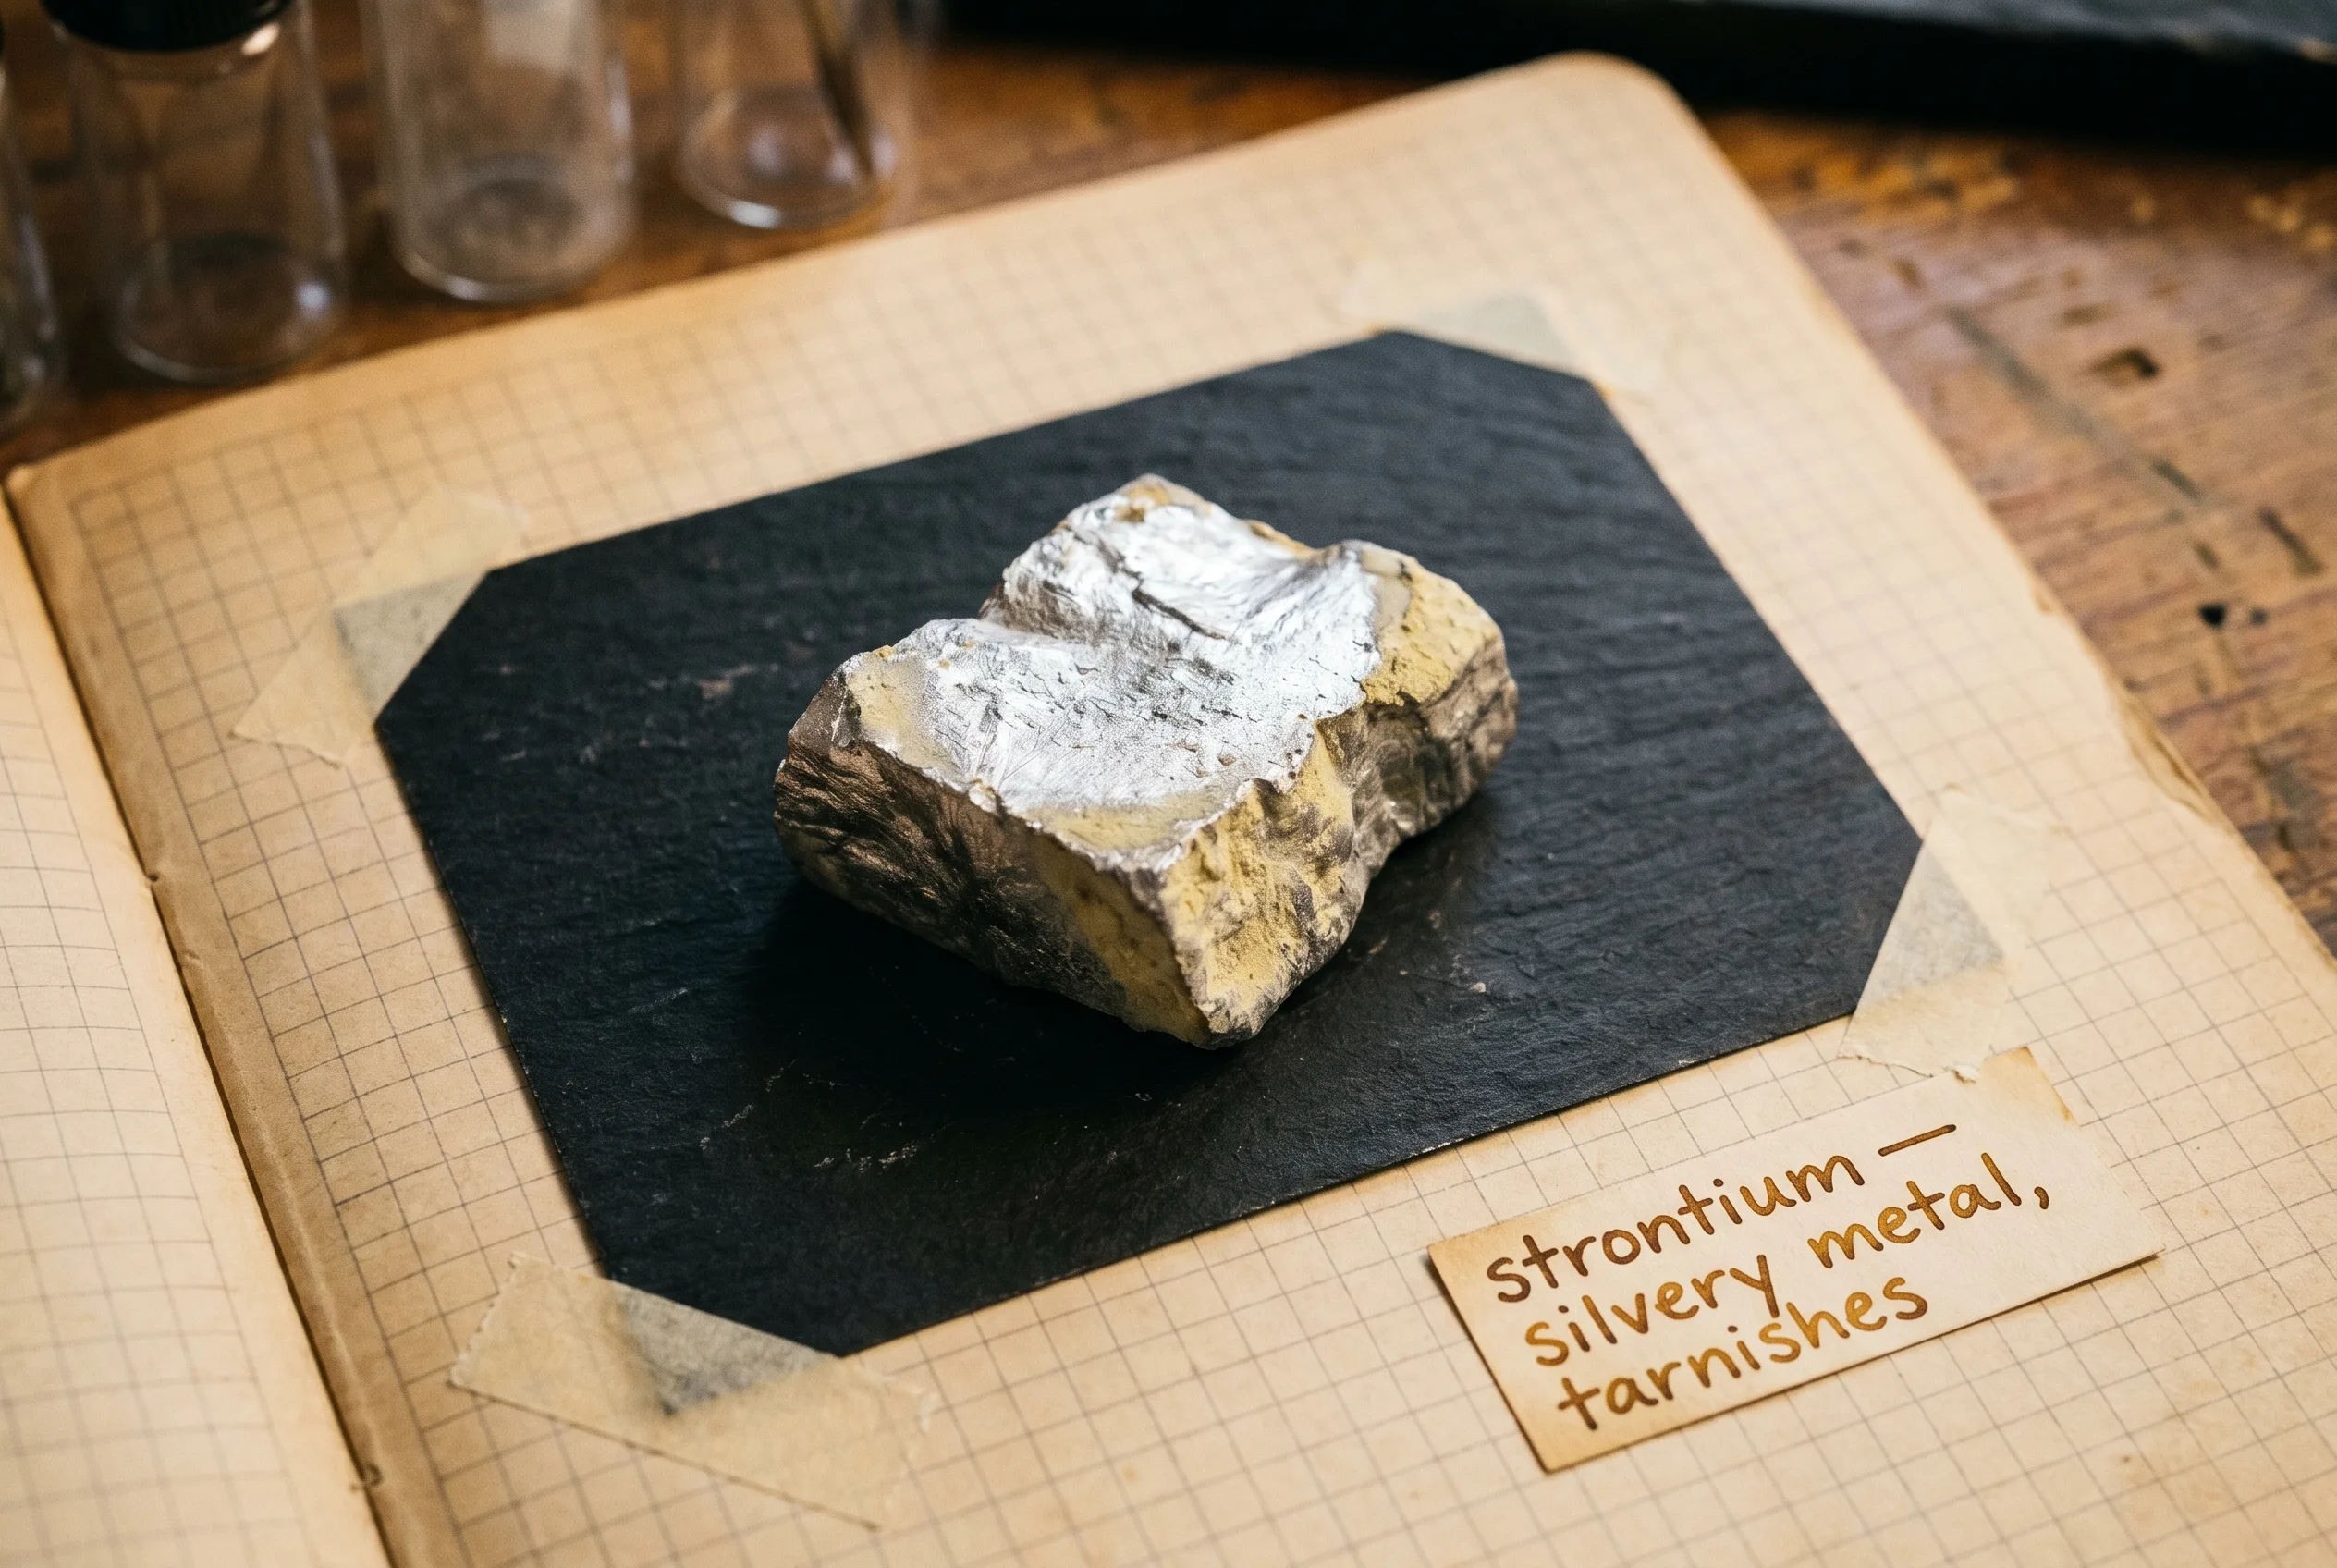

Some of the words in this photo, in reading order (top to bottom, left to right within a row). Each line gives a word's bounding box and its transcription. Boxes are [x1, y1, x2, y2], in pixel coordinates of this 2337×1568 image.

[1486, 1155, 1866, 1304] strontium
[1524, 1254, 1780, 1367] silvery
[1807, 1152, 2049, 1269] metal,
[1557, 1277, 1928, 1432] tarnishes
